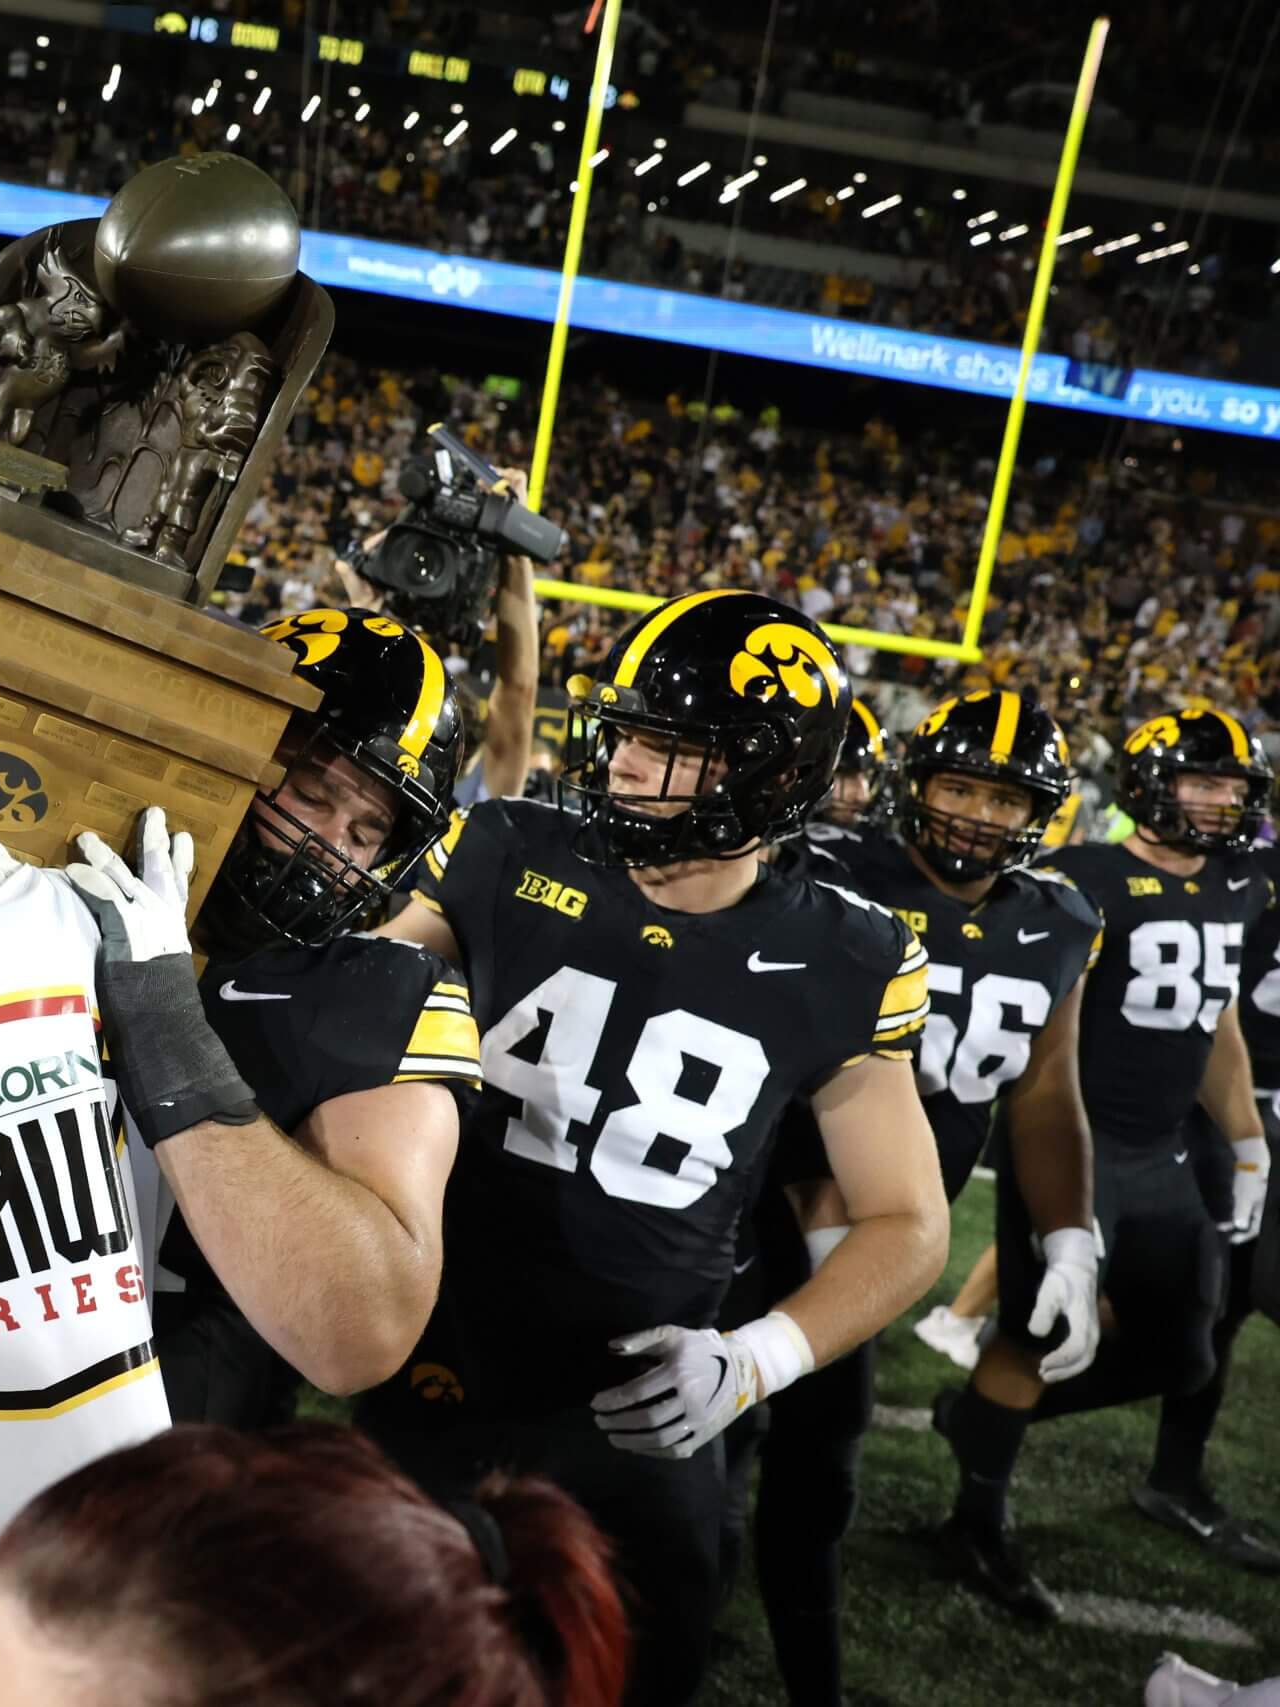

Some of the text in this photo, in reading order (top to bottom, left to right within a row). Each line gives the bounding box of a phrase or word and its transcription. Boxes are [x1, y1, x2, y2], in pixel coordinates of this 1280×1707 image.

[810, 323, 949, 376] Wellmark
[1220, 396, 1261, 425] so
[1120, 920, 1244, 1033] 85
[479, 965, 771, 1210] 48
